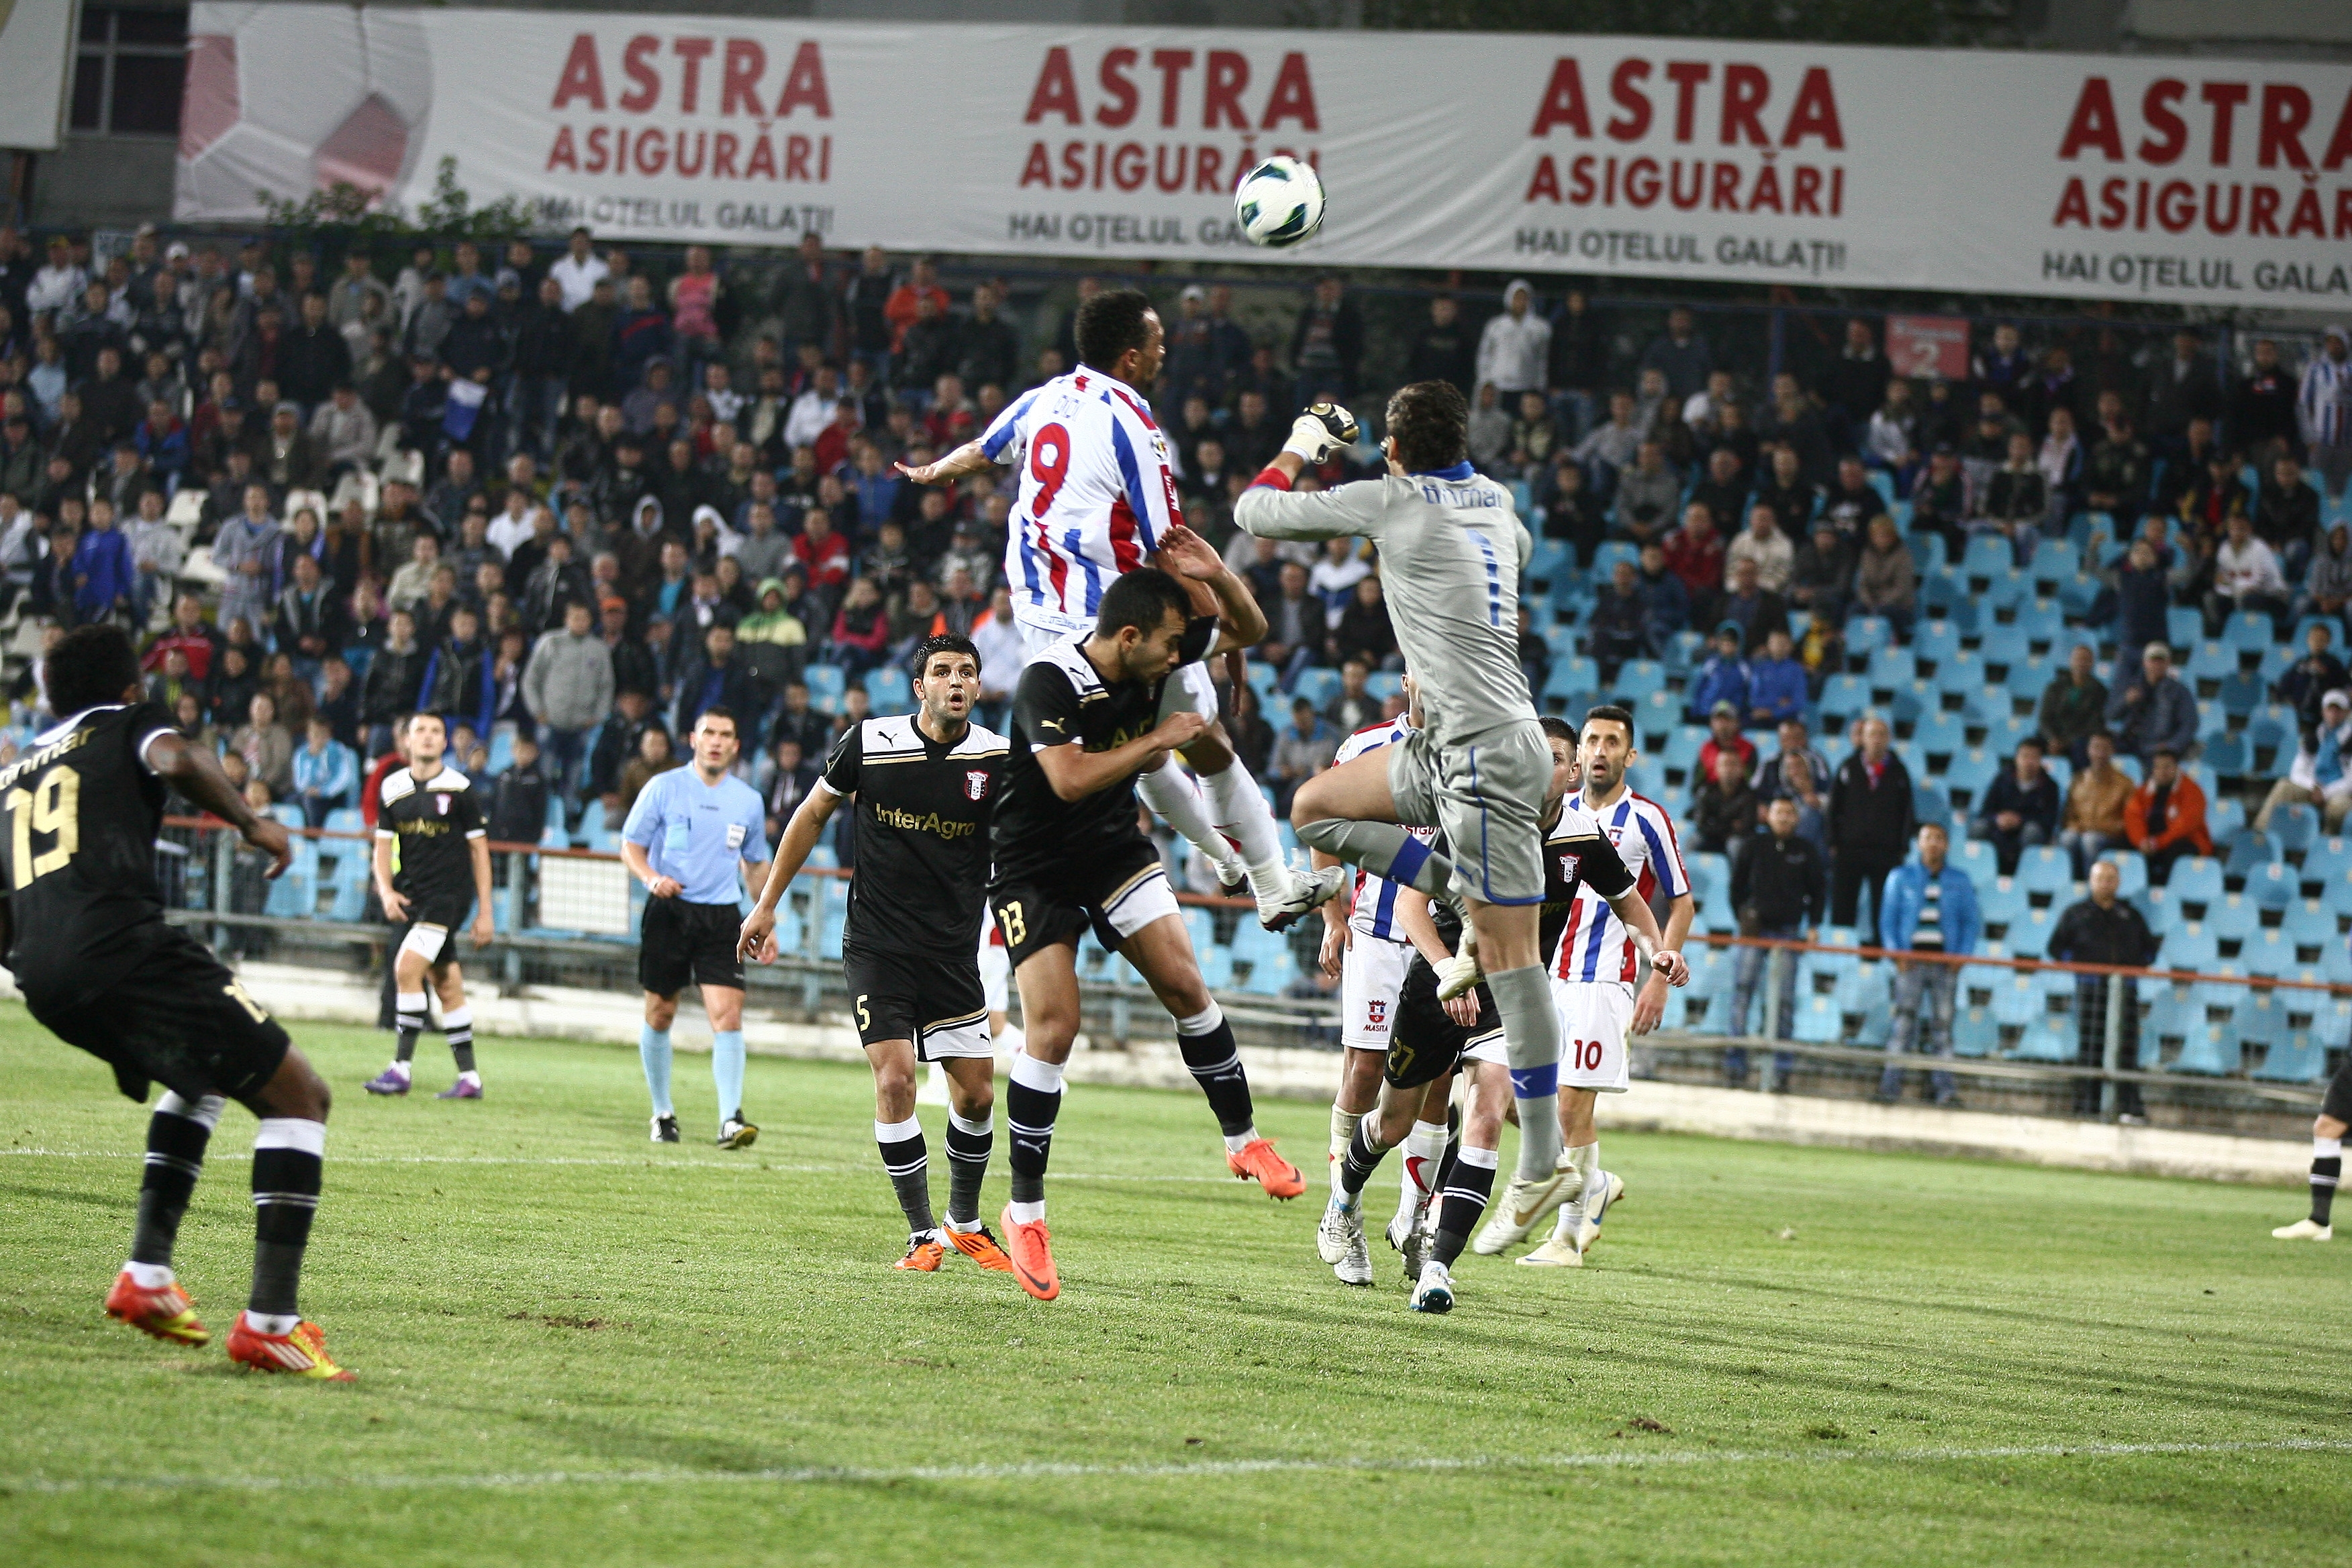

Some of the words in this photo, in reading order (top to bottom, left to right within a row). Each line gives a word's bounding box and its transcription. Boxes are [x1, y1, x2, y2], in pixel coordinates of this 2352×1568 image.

[550, 33, 834, 119] ASTRA
[1024, 46, 1320, 132] ASTRA
[1530, 56, 1845, 151] ASTRA
[546, 121, 833, 183] ASIGURĂRI
[1020, 136, 1320, 195] ASIGURĂ
[1524, 150, 1845, 217] ASIGURĂRI
[1008, 212, 1061, 242] HAI
[1514, 227, 1571, 256] HAI
[2042, 250, 2100, 281] HAI
[1911, 342, 1940, 379] 2
[1032, 422, 1070, 518] 9
[1465, 529, 1501, 628] 1
[5, 764, 80, 891] 19
[876, 803, 976, 840] InterAgro
[998, 900, 1027, 948] 13
[856, 993, 871, 1032] 5
[1363, 1024, 1388, 1032] MASITA
[1388, 1036, 1416, 1077] 27
[1574, 1038, 1603, 1070] 10
